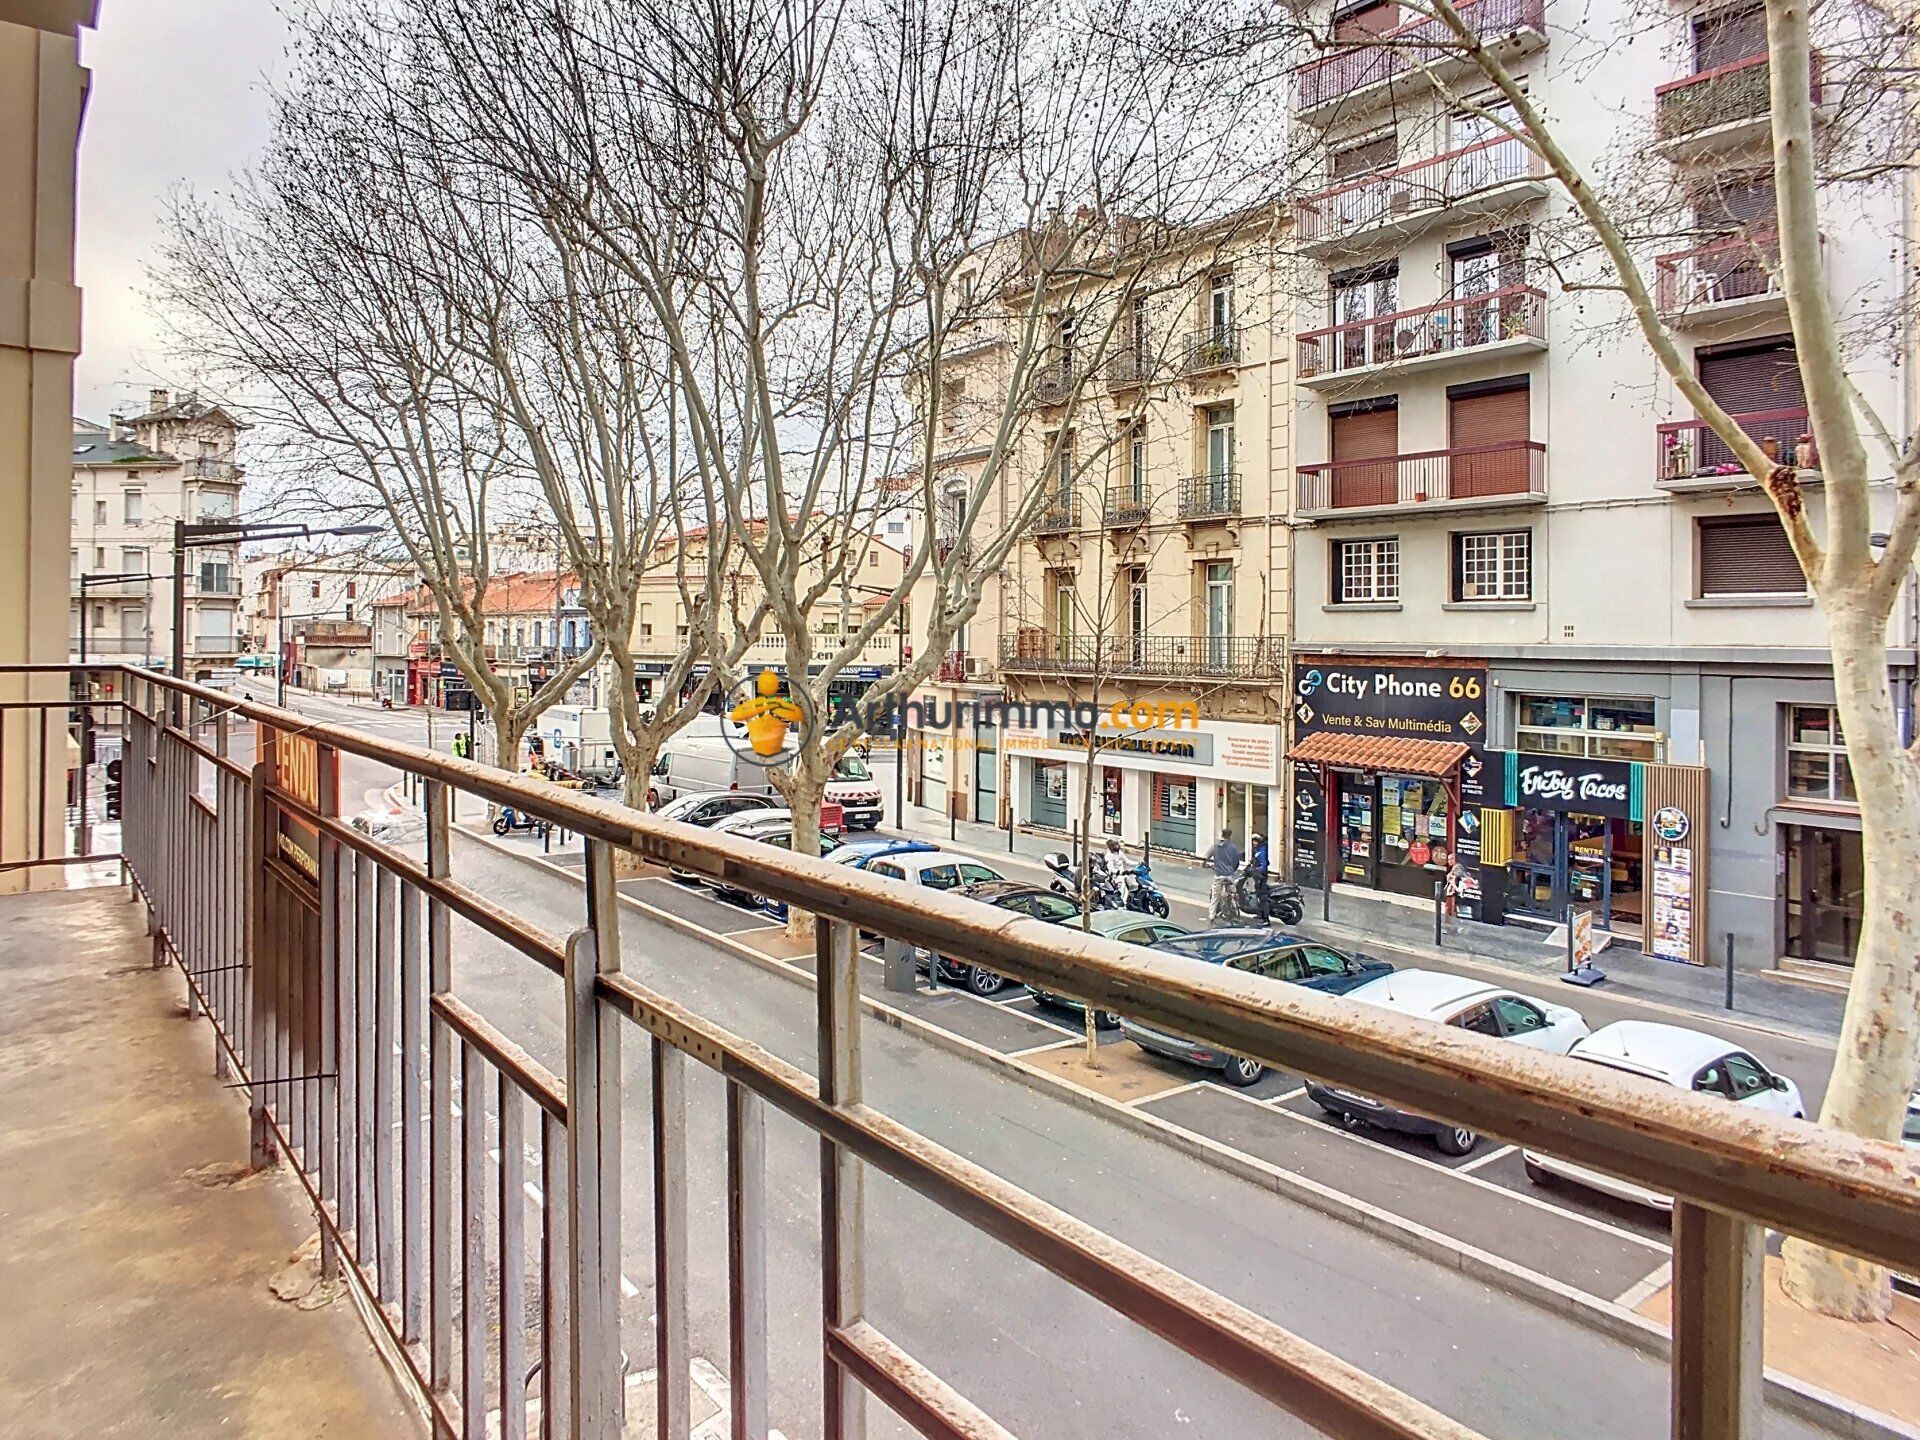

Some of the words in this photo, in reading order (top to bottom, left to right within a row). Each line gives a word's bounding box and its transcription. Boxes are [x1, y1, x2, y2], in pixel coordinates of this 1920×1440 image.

[1326, 672, 1368, 699] City
[1374, 673, 1442, 697] Phone
[1449, 676, 1481, 699] 66
[1322, 713, 1351, 726] Vente
[1354, 715, 1362, 727] &
[1365, 716, 1385, 728] Sav
[1388, 717, 1452, 732] Multimédia
[1578, 773, 1628, 800] Tacos
